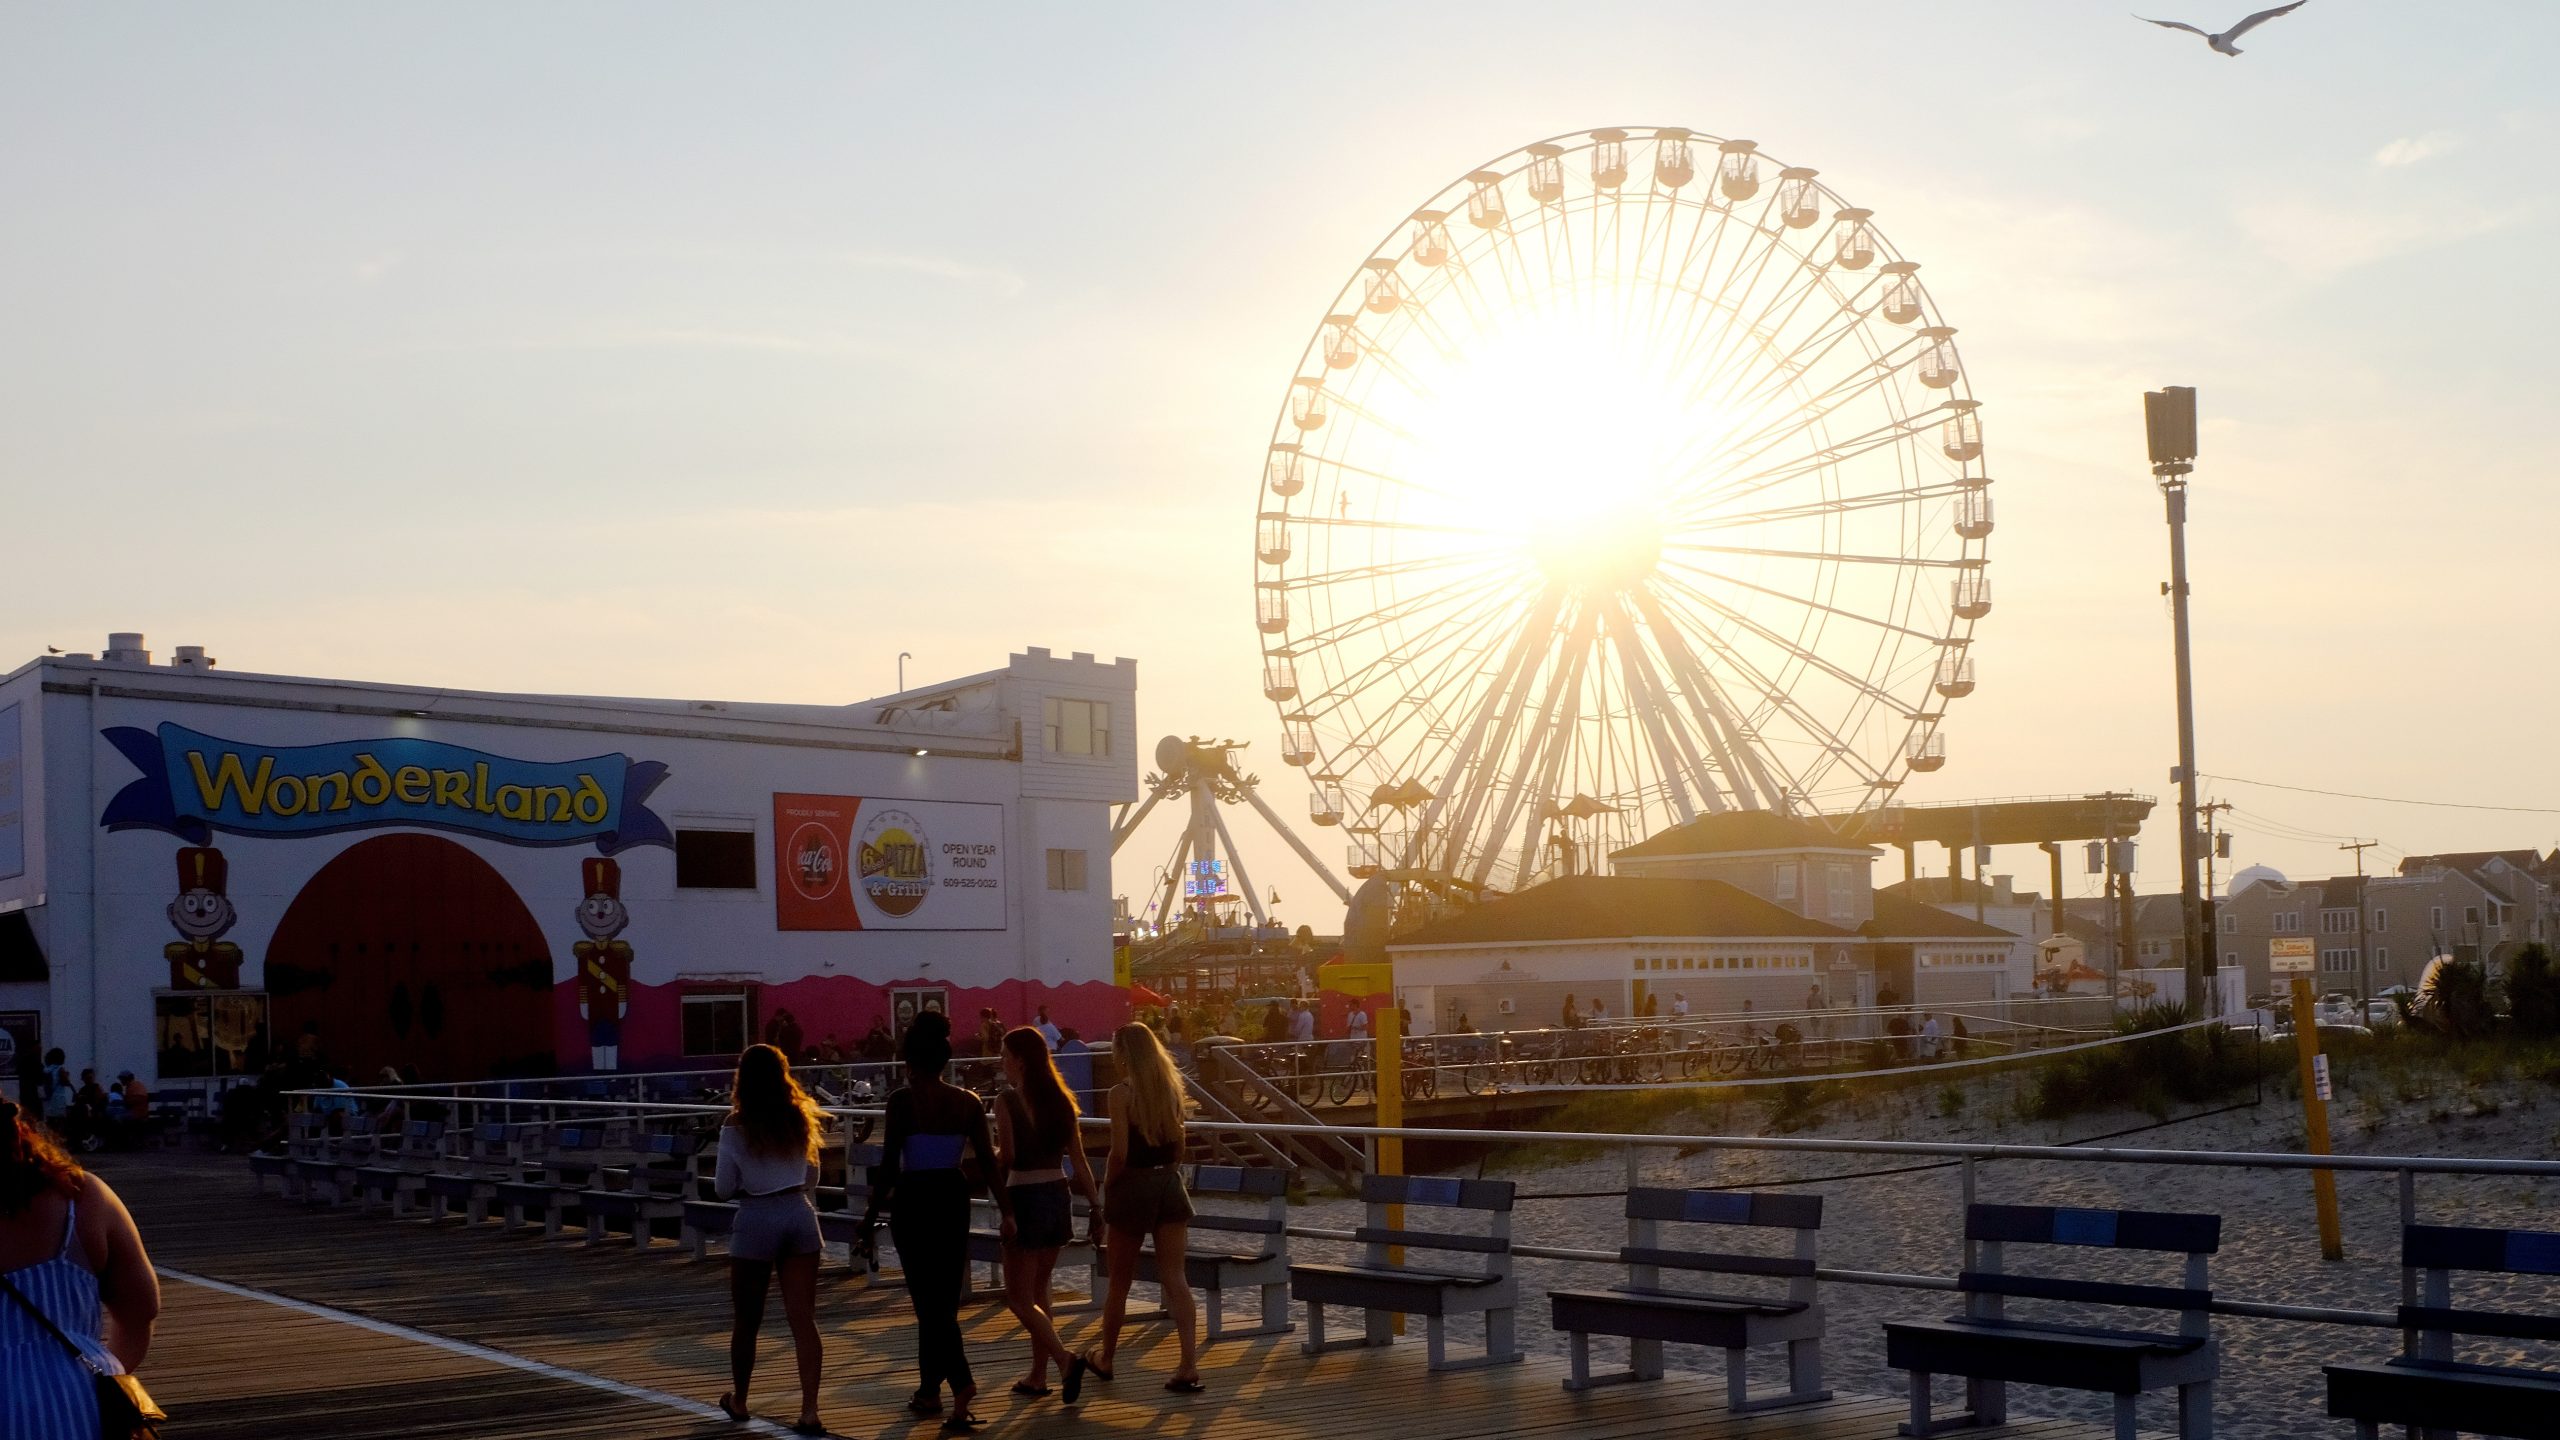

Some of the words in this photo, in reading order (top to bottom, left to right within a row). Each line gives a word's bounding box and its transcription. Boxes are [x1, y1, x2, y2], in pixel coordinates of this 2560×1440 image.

[187, 751, 608, 824] Wonderland
[943, 843, 969, 855] OPEN
[971, 844, 996, 855] YEAR
[953, 857, 987, 868] ROUND
[887, 882, 923, 897] Grill
